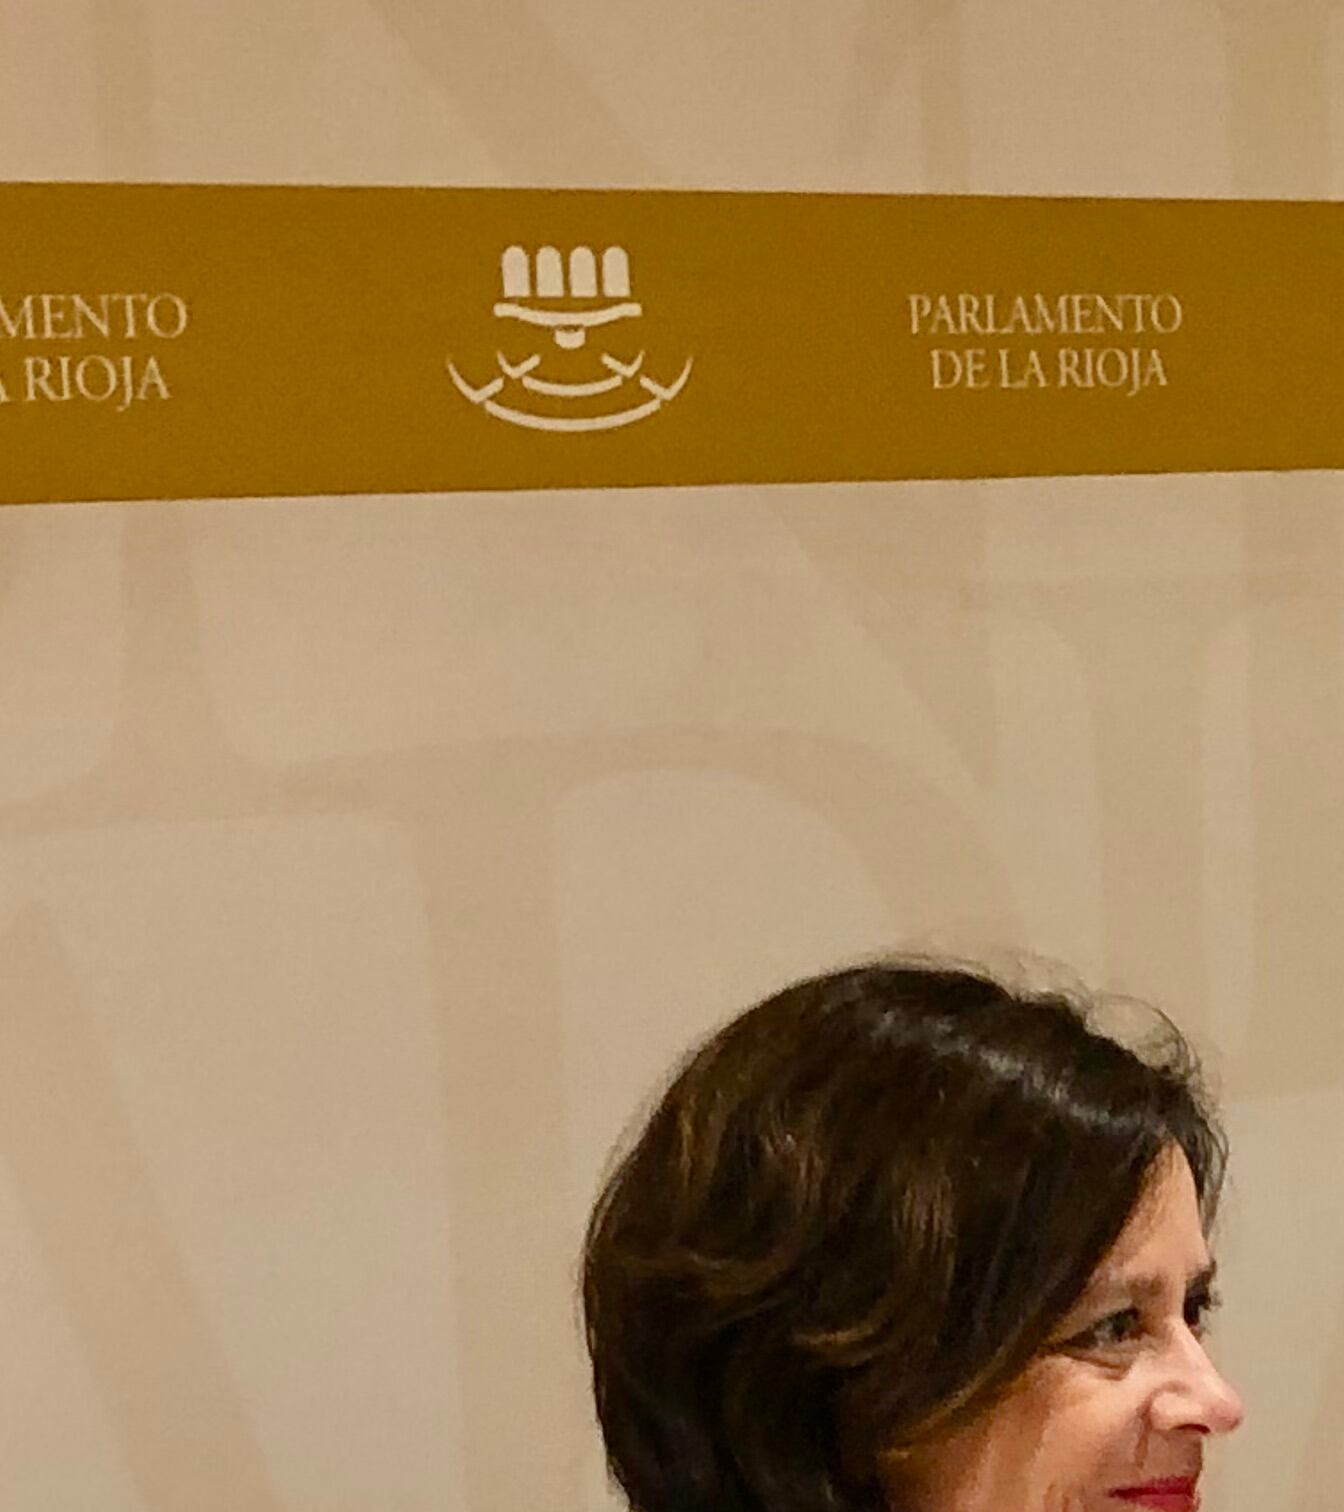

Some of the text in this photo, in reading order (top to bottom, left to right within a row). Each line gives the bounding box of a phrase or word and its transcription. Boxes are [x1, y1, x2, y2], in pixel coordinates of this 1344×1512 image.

[908, 293, 1183, 335] PARLAMENTO
[23, 355, 171, 413] RIOJA
[931, 348, 1168, 397] DE LA RIOJA
